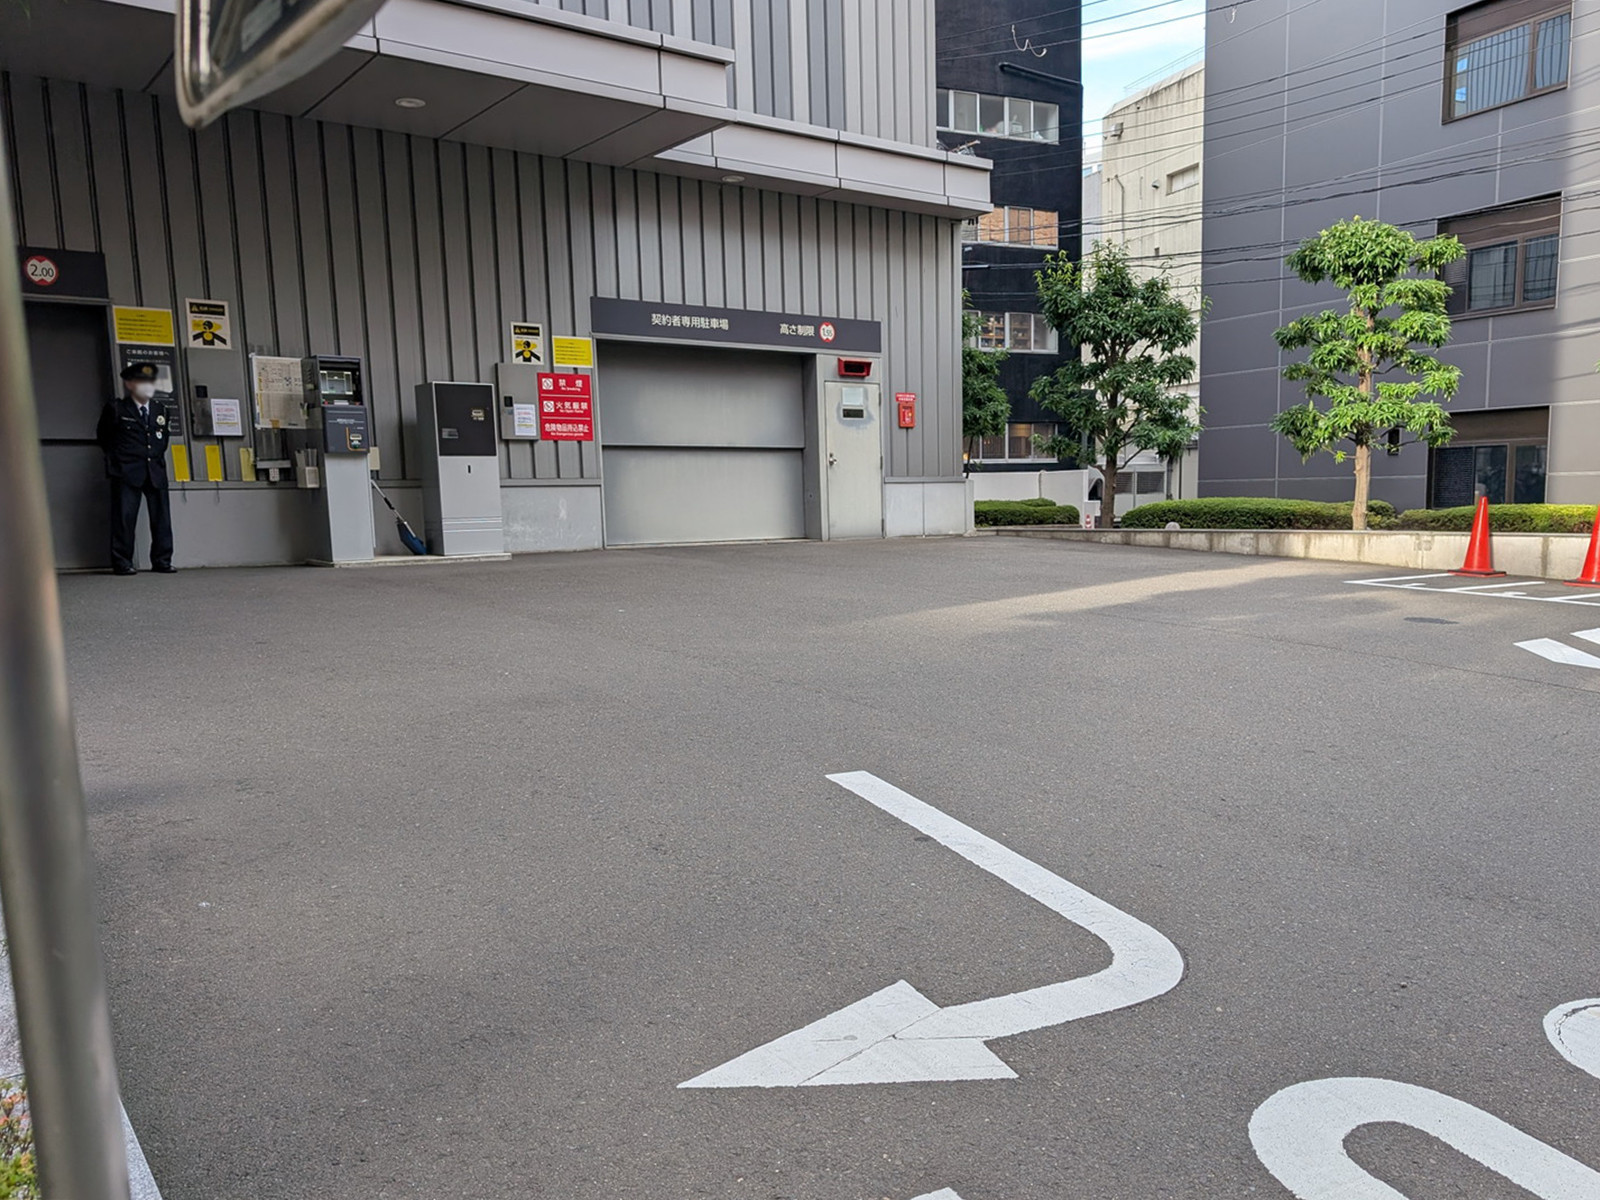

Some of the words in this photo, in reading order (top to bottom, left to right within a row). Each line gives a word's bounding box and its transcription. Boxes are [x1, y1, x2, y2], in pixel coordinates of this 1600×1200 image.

[30, 263, 55, 278] 2.00
[650, 313, 729, 331] 契約者専用駐車場
[779, 323, 815, 337] 高さ制限
[555, 400, 588, 411] 火気厳禁
